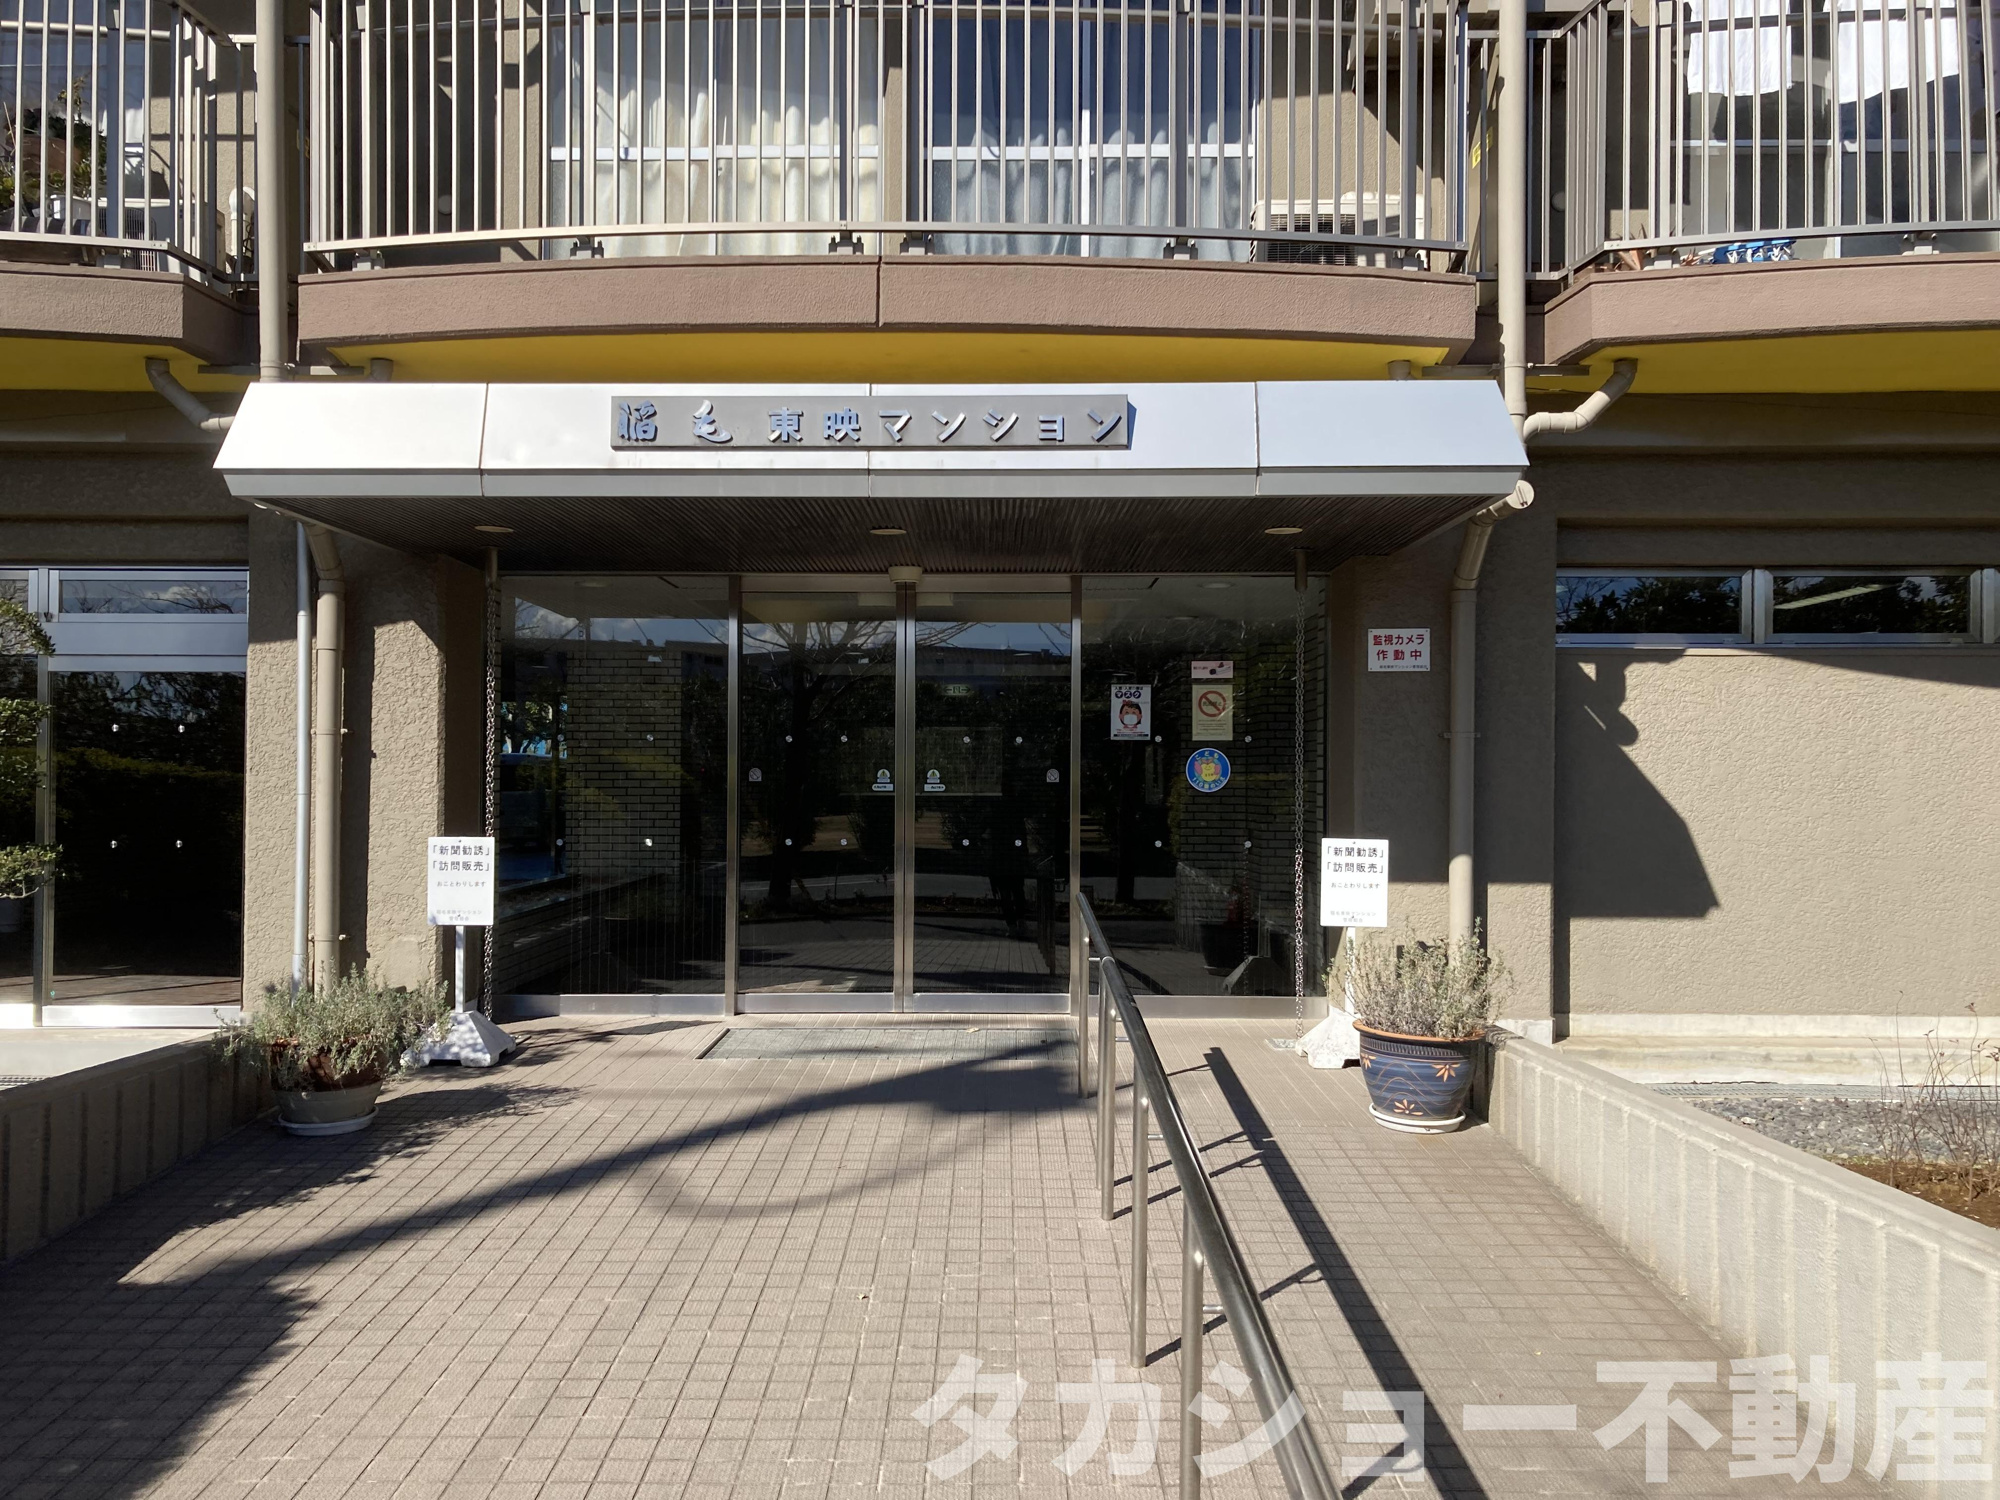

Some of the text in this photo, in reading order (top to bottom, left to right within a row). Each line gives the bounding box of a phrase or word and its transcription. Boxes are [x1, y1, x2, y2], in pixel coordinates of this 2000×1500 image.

[1373, 634, 1425, 646] 監視カメラ
[1376, 649, 1422, 661] 作動中
[1195, 751, 1219, 760] こども
[433, 845, 490, 856] 「新聞勧誘」
[1327, 846, 1384, 858] 「新聞勧誘」
[433, 861, 490, 872] 「訪問販売」
[1327, 862, 1384, 874] 「訪問販売」
